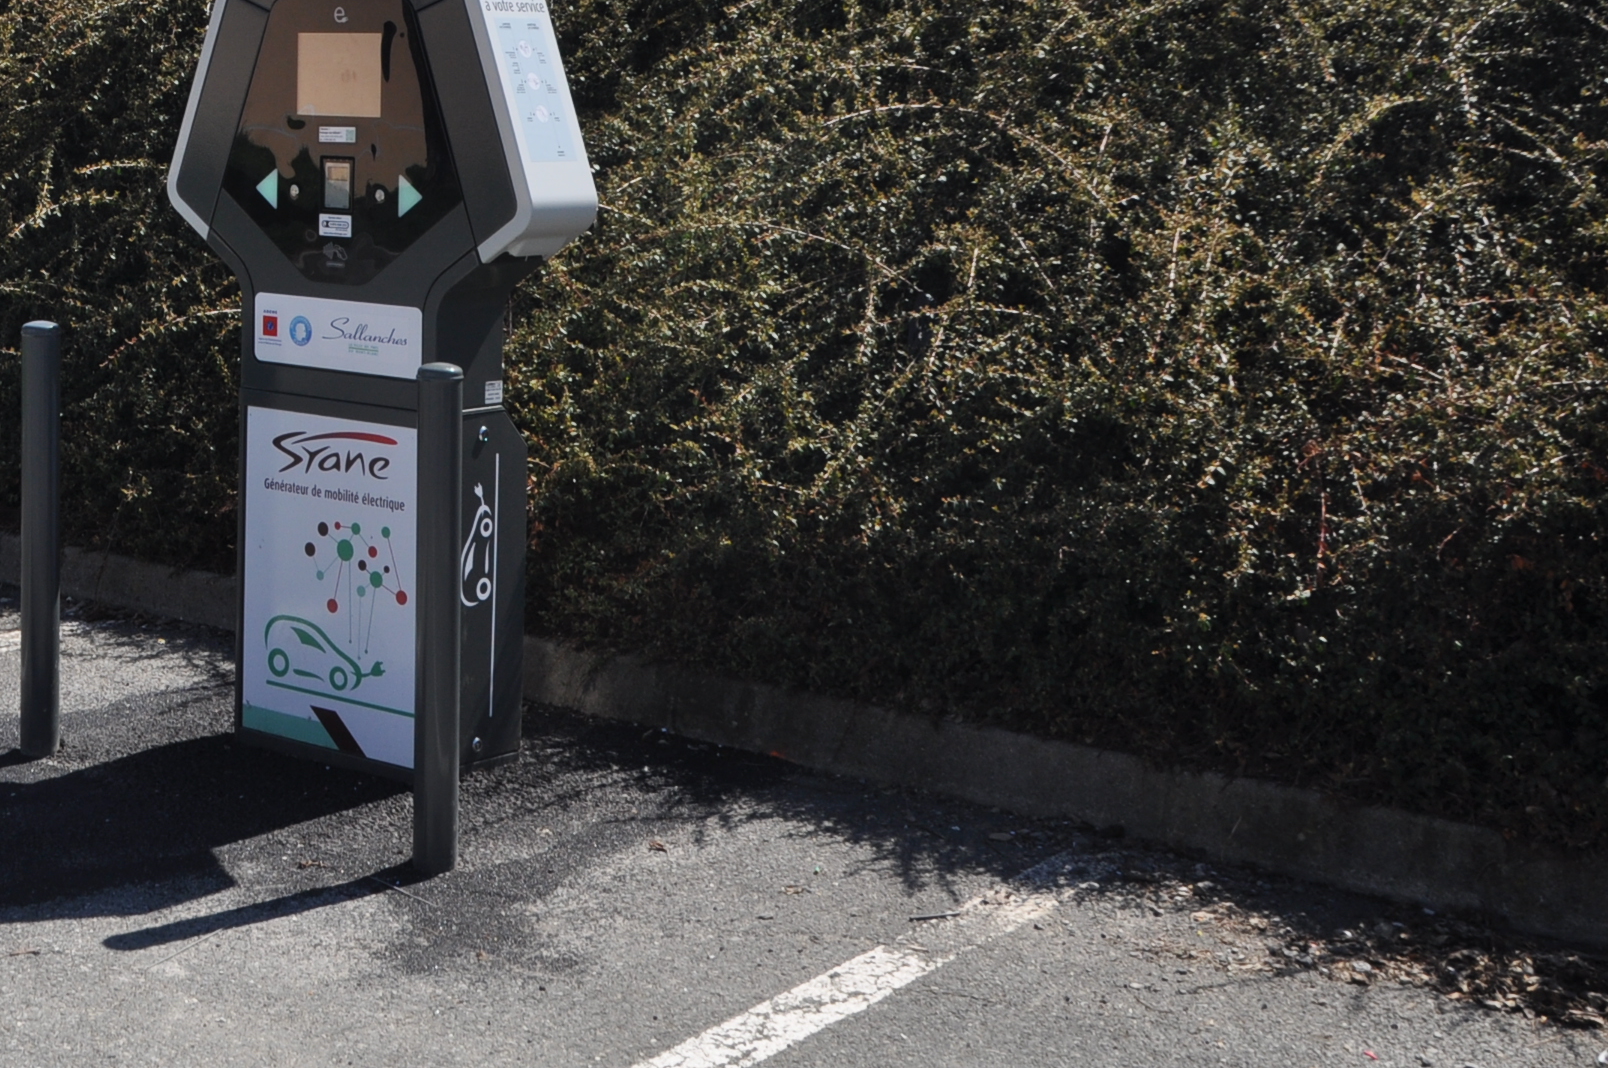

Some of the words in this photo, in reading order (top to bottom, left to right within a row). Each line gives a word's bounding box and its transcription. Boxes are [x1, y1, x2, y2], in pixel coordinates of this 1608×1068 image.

[492, 0, 515, 12] votre
[515, 0, 546, 13] service
[321, 317, 408, 346] Sallanches
[264, 477, 309, 496] Générateur
[311, 484, 322, 498] de
[324, 487, 359, 504] mobilité
[362, 493, 406, 513] électrique
